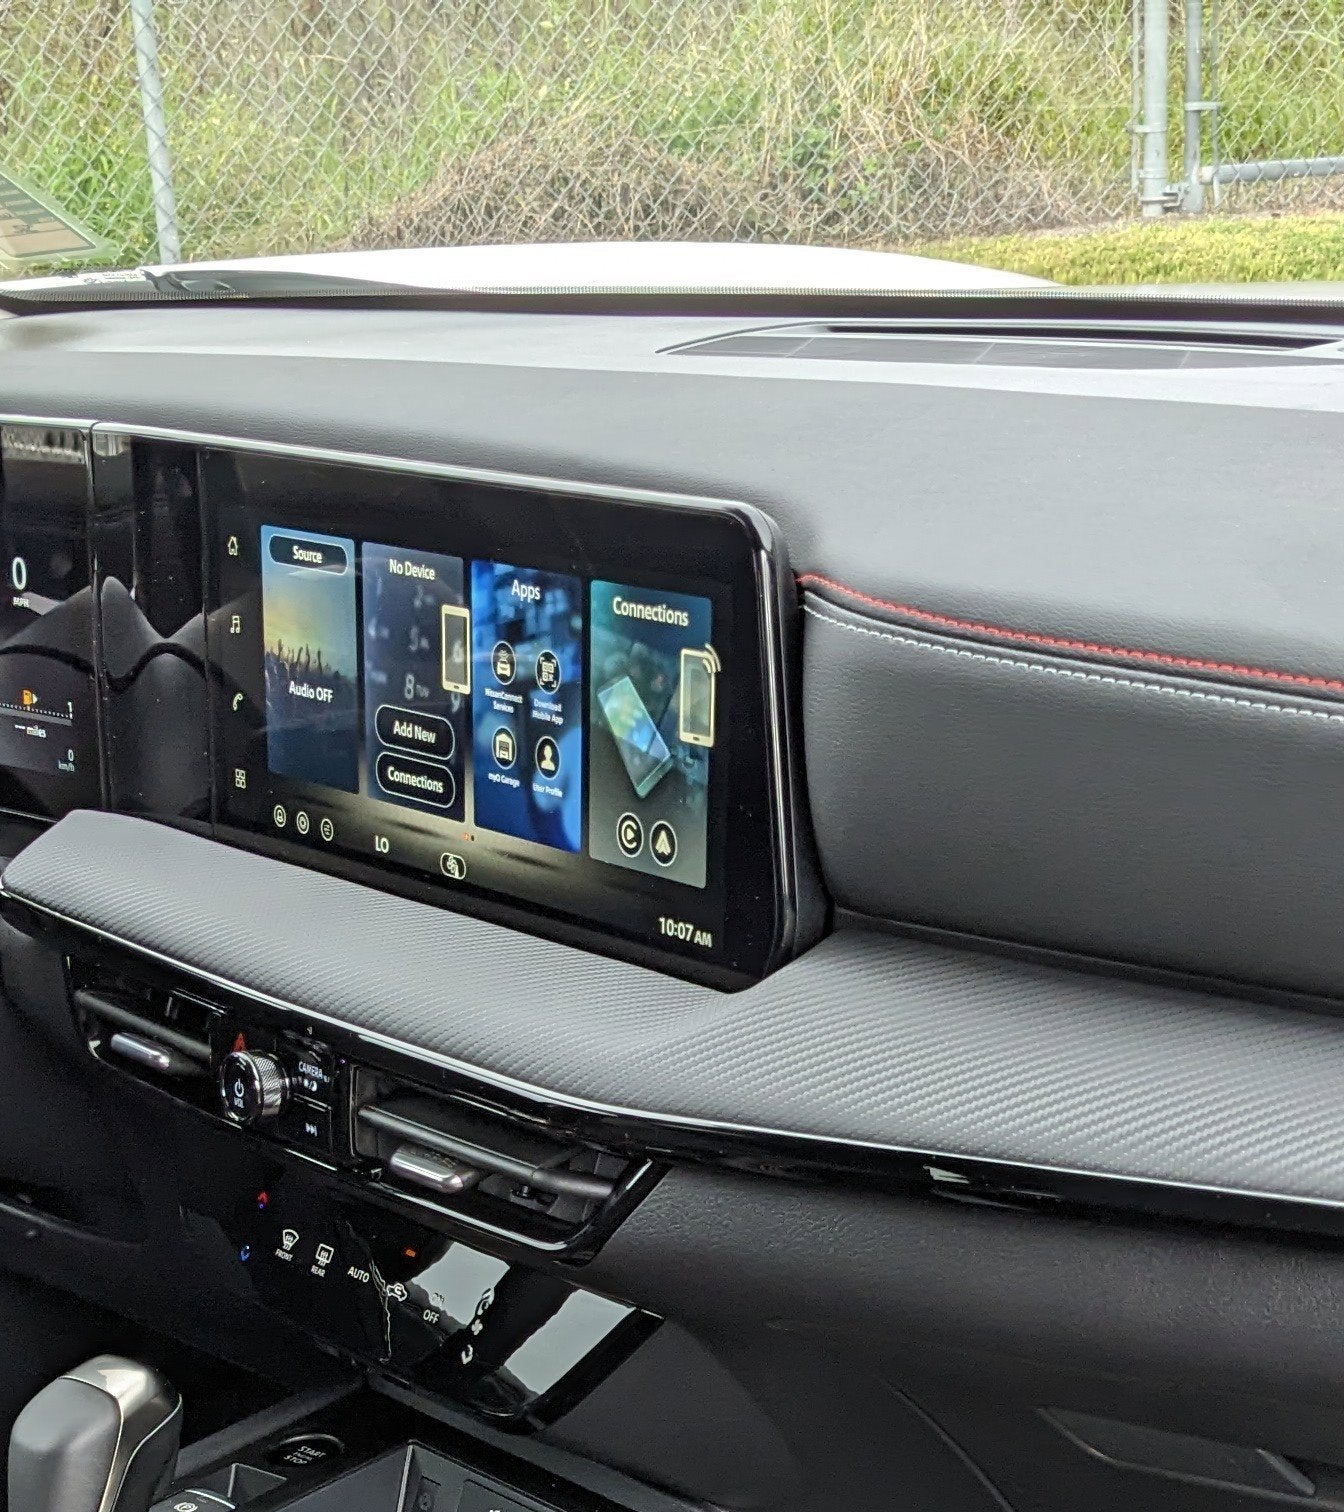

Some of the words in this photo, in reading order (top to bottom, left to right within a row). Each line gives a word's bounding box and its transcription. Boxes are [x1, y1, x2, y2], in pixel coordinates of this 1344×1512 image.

[293, 545, 323, 564] Source
[12, 557, 26, 590] 0
[389, 559, 402, 574] No
[406, 562, 435, 580] Device
[511, 579, 541, 602] Apps
[613, 597, 689, 627] Connections
[289, 681, 314, 699] Audio
[317, 687, 333, 703] OFF
[393, 720, 412, 738] Add
[415, 725, 436, 744] New
[387, 766, 444, 793] Connections
[375, 835, 389, 853] LO
[659, 916, 694, 941] 10:07
[694, 930, 712, 948] AM
[275, 1249, 293, 1261] FRONT
[311, 1265, 325, 1277] REAR
[347, 1266, 370, 1283] AUTO
[423, 1309, 439, 1324] OFF
[284, 1455, 307, 1464] STOP
[298, 1446, 326, 1457] START
